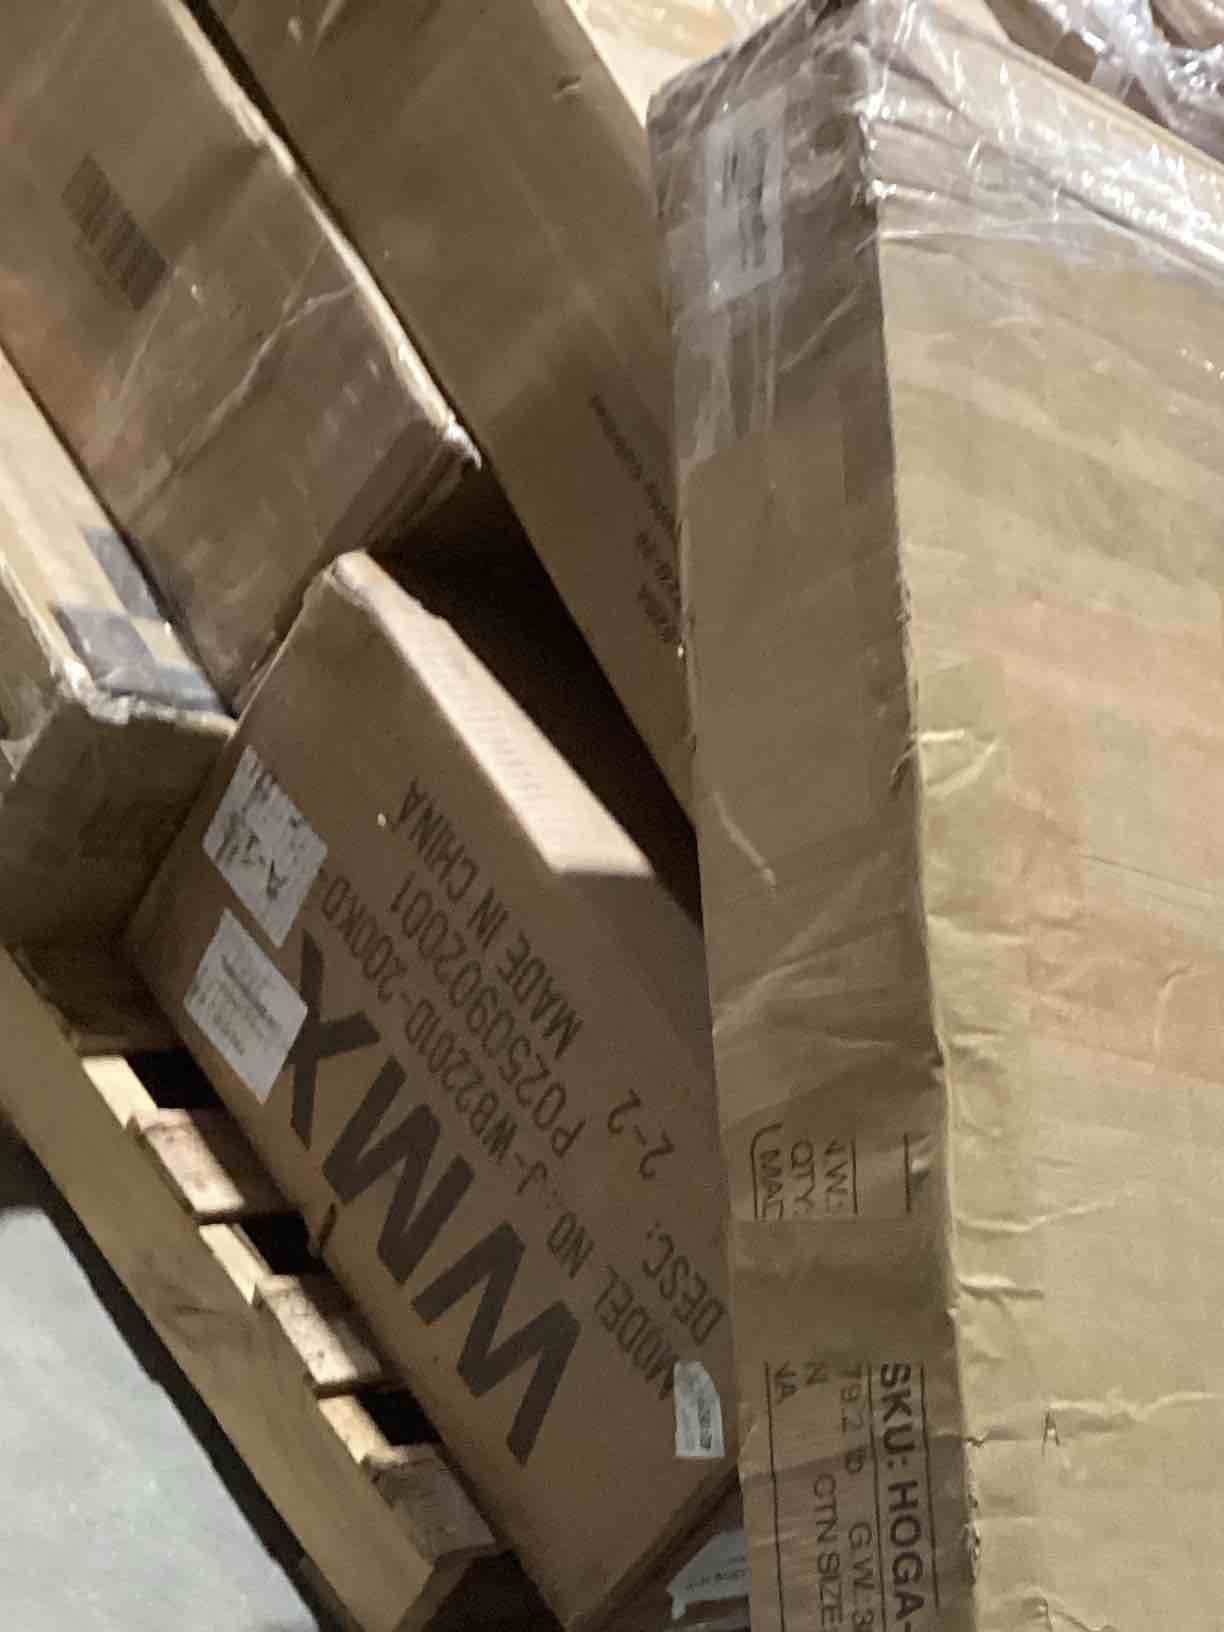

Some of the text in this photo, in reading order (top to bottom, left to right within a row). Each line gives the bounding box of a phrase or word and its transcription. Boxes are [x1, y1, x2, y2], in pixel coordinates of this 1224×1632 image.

[396, 775, 677, 1182] 2-2 MADE IN CHINA
[878, 1361, 917, 1469] SKU:
